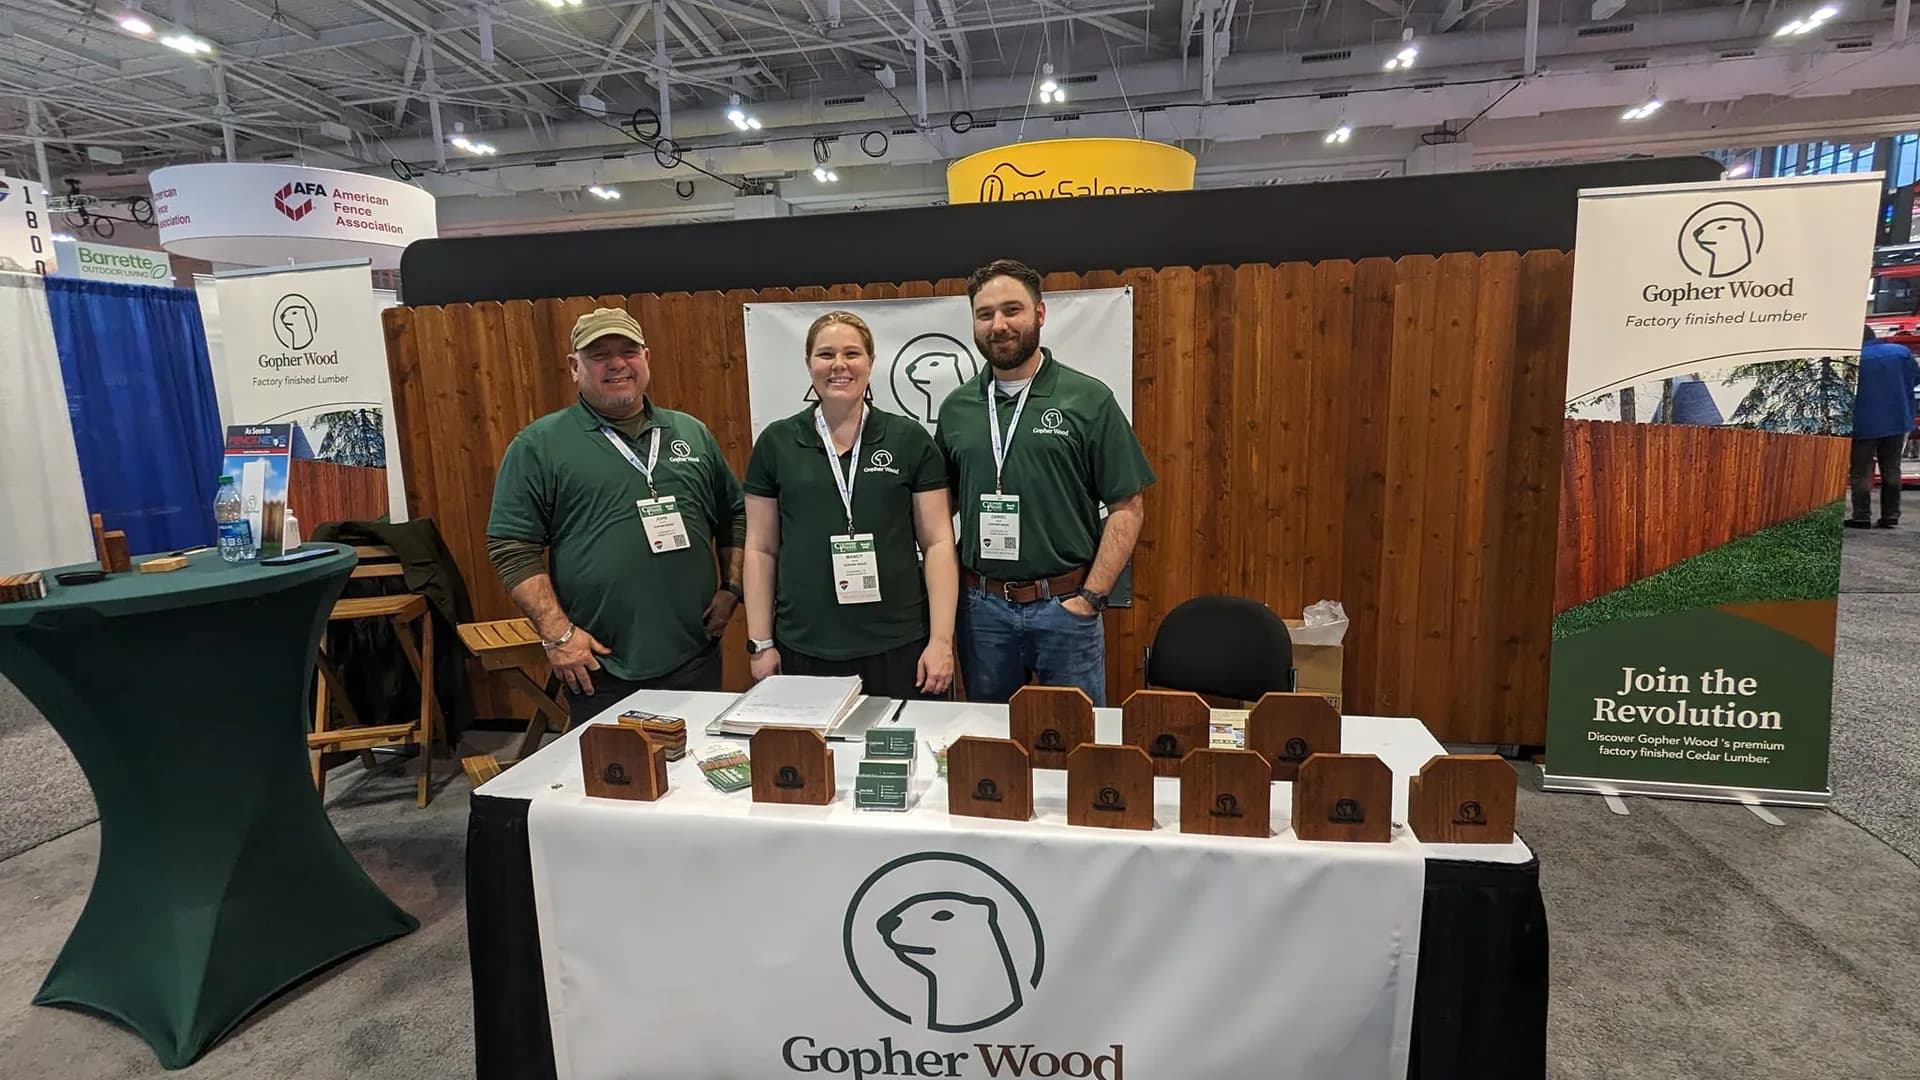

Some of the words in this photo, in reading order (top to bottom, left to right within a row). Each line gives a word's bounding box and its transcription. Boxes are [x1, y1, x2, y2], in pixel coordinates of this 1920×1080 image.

[293, 182, 328, 197] AFA
[332, 189, 389, 206] American
[333, 202, 373, 216] Fence
[335, 216, 403, 234] Association
[78, 247, 152, 270] Barrette
[81, 265, 124, 276] OUTDOOR
[1642, 282, 1724, 307] Gopher
[1728, 277, 1794, 299] Wood
[1625, 315, 1681, 329] Factory
[1684, 311, 1746, 326] finished
[1749, 309, 1808, 324] Lumber
[258, 353, 302, 371] Gopher
[304, 350, 338, 365] Wood
[252, 377, 281, 388] Factory
[285, 375, 316, 385] finished
[318, 374, 349, 384] Lumber
[1617, 666, 1690, 696] Join
[1700, 668, 1758, 696] the
[1592, 698, 1783, 730] Revolution
[1587, 731, 1636, 743] Discover
[1637, 733, 1681, 747] Gopher
[1683, 736, 1718, 747] Wood
[1732, 740, 1785, 751] premium
[1598, 745, 1638, 759] factory
[1640, 747, 1684, 759] finished
[1686, 750, 1721, 761] Cedar
[1724, 752, 1770, 764] Lumber.
[782, 1036, 969, 1080] Gopher
[974, 1044, 1124, 1080] Wood
